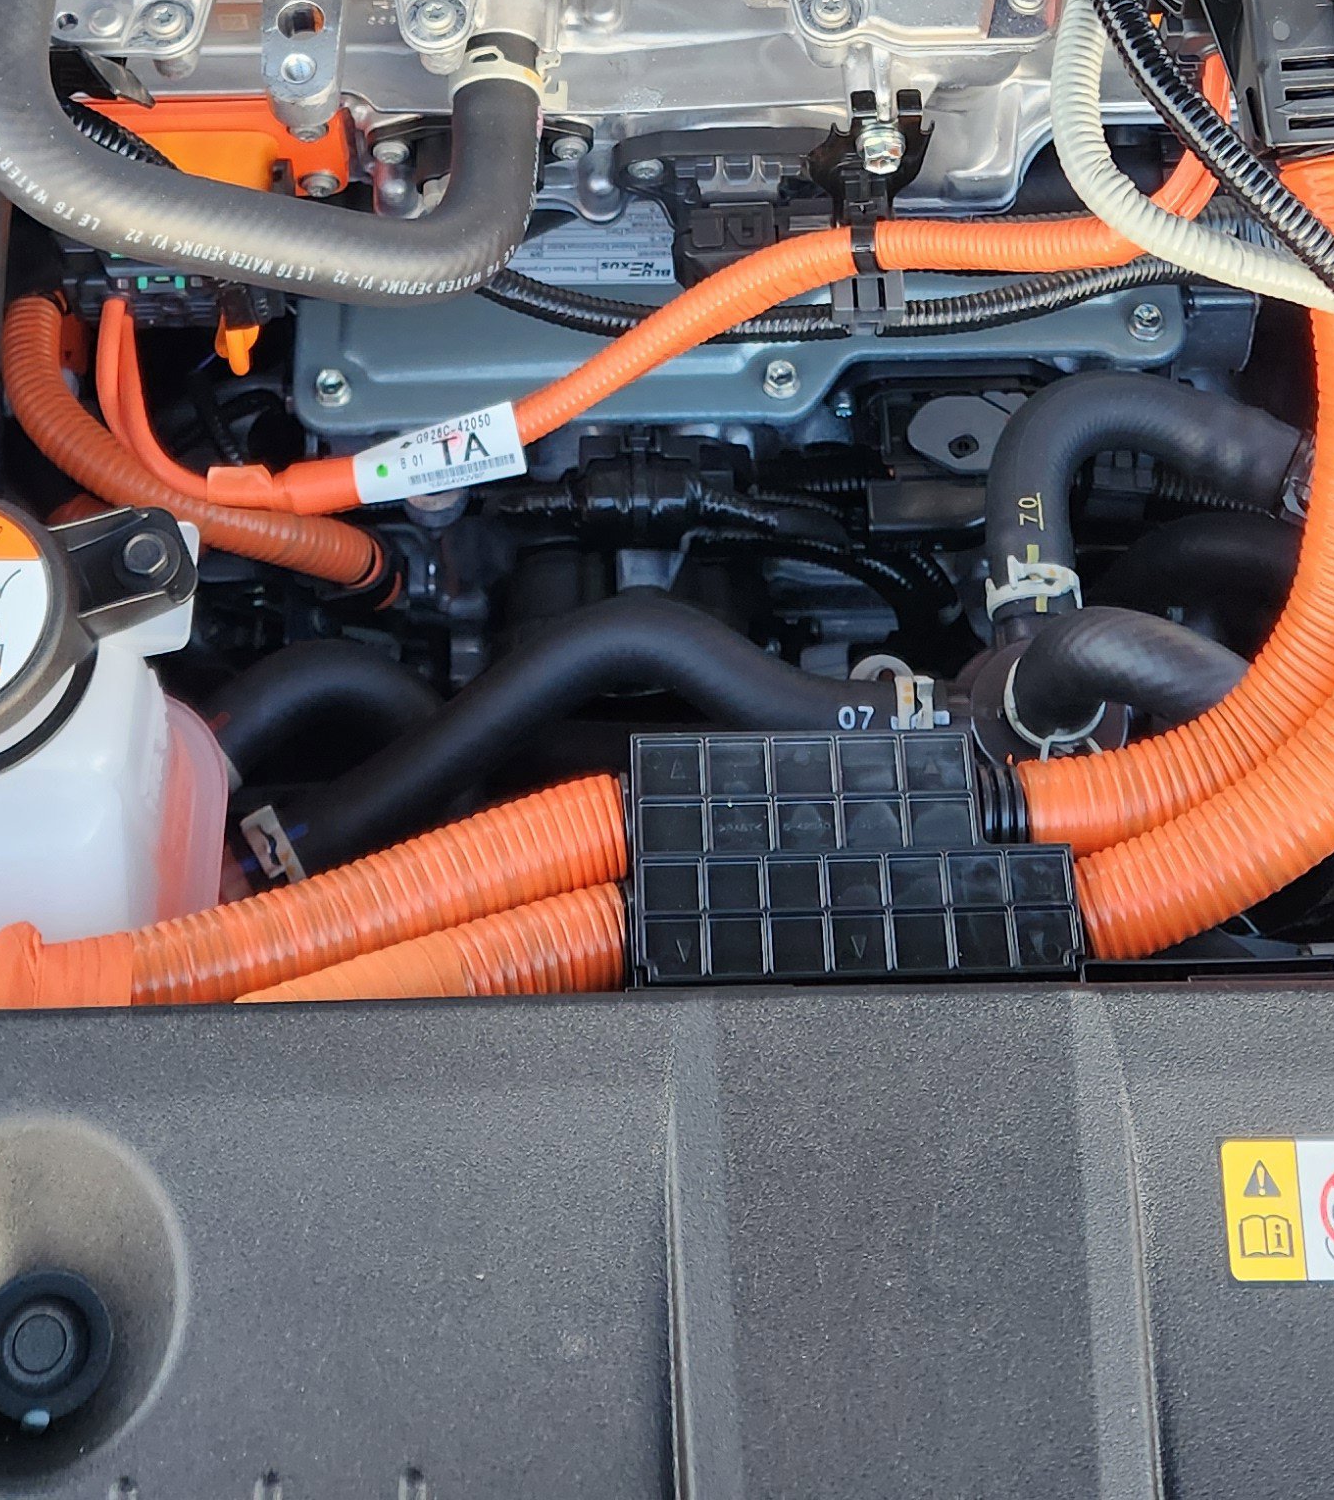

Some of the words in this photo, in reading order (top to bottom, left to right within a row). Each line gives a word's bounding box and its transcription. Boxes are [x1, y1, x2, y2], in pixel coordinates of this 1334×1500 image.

[0, 157, 49, 205] WATER
[53, 201, 75, 220] TG
[78, 213, 101, 231] LE
[229, 251, 274, 275] WATER
[298, 270, 315, 282] LE
[333, 269, 374, 291] VJ-22
[436, 271, 482, 294] WATER
[432, 432, 490, 466] TA
[1018, 496, 1038, 527] 70
[838, 706, 875, 730] 07
